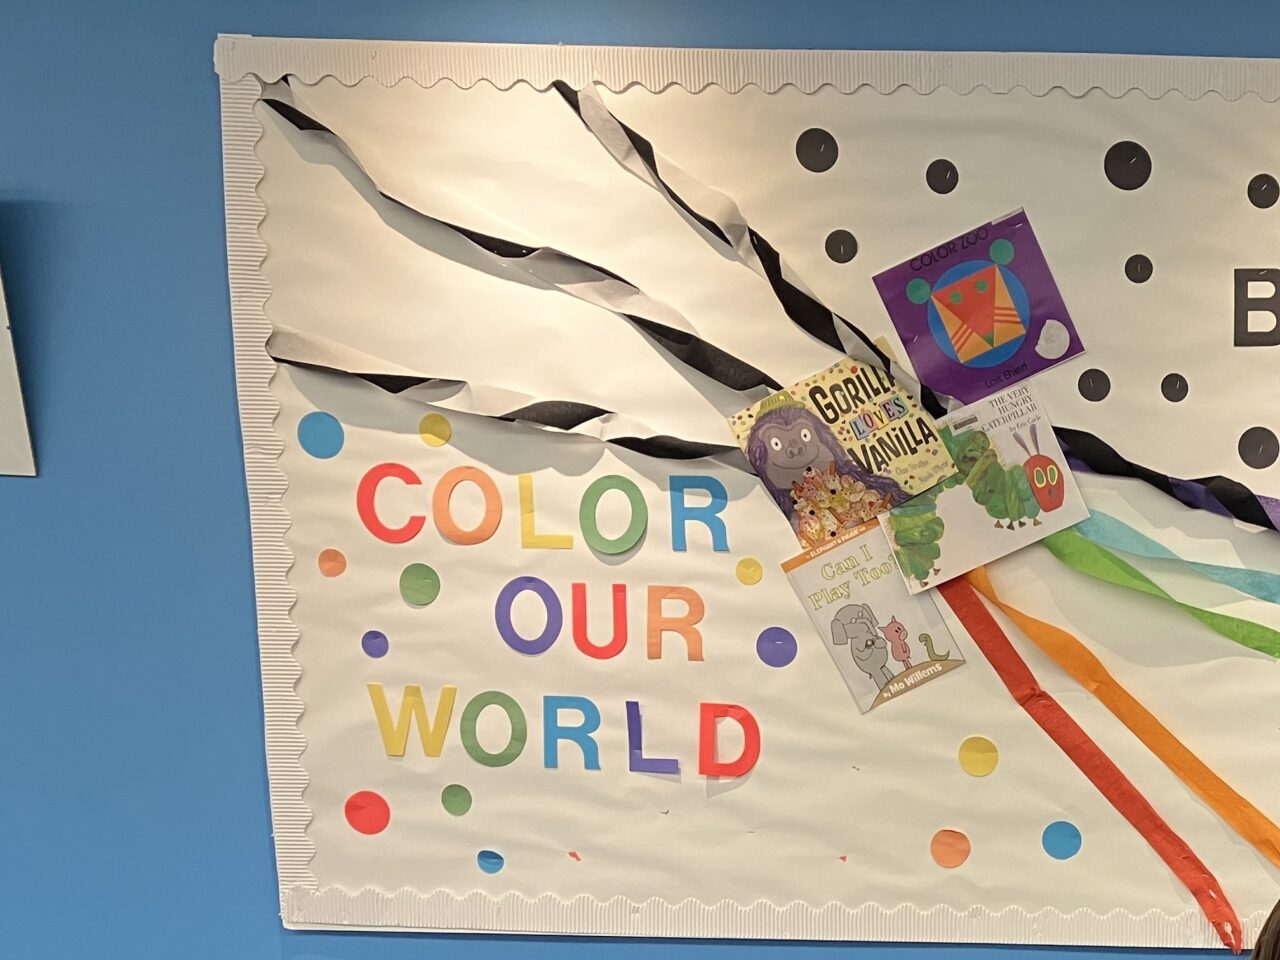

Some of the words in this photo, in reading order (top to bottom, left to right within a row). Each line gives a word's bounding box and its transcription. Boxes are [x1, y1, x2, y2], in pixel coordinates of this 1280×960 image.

[910, 241, 957, 271] COLOR
[961, 227, 989, 250] ZOO
[988, 395, 1007, 408] THE
[1007, 385, 1029, 400] VERY
[997, 393, 1033, 415] HUNGRY
[851, 396, 907, 437] LOVES
[981, 402, 1038, 432] CATERPILLAR
[356, 461, 730, 555] COLOR
[820, 555, 860, 581] Can
[859, 543, 873, 562] I
[808, 580, 850, 611] Play
[494, 575, 706, 662] OUR
[889, 682, 906, 694] Mo
[903, 663, 944, 687] Willems
[367, 683, 761, 777] WORLD
